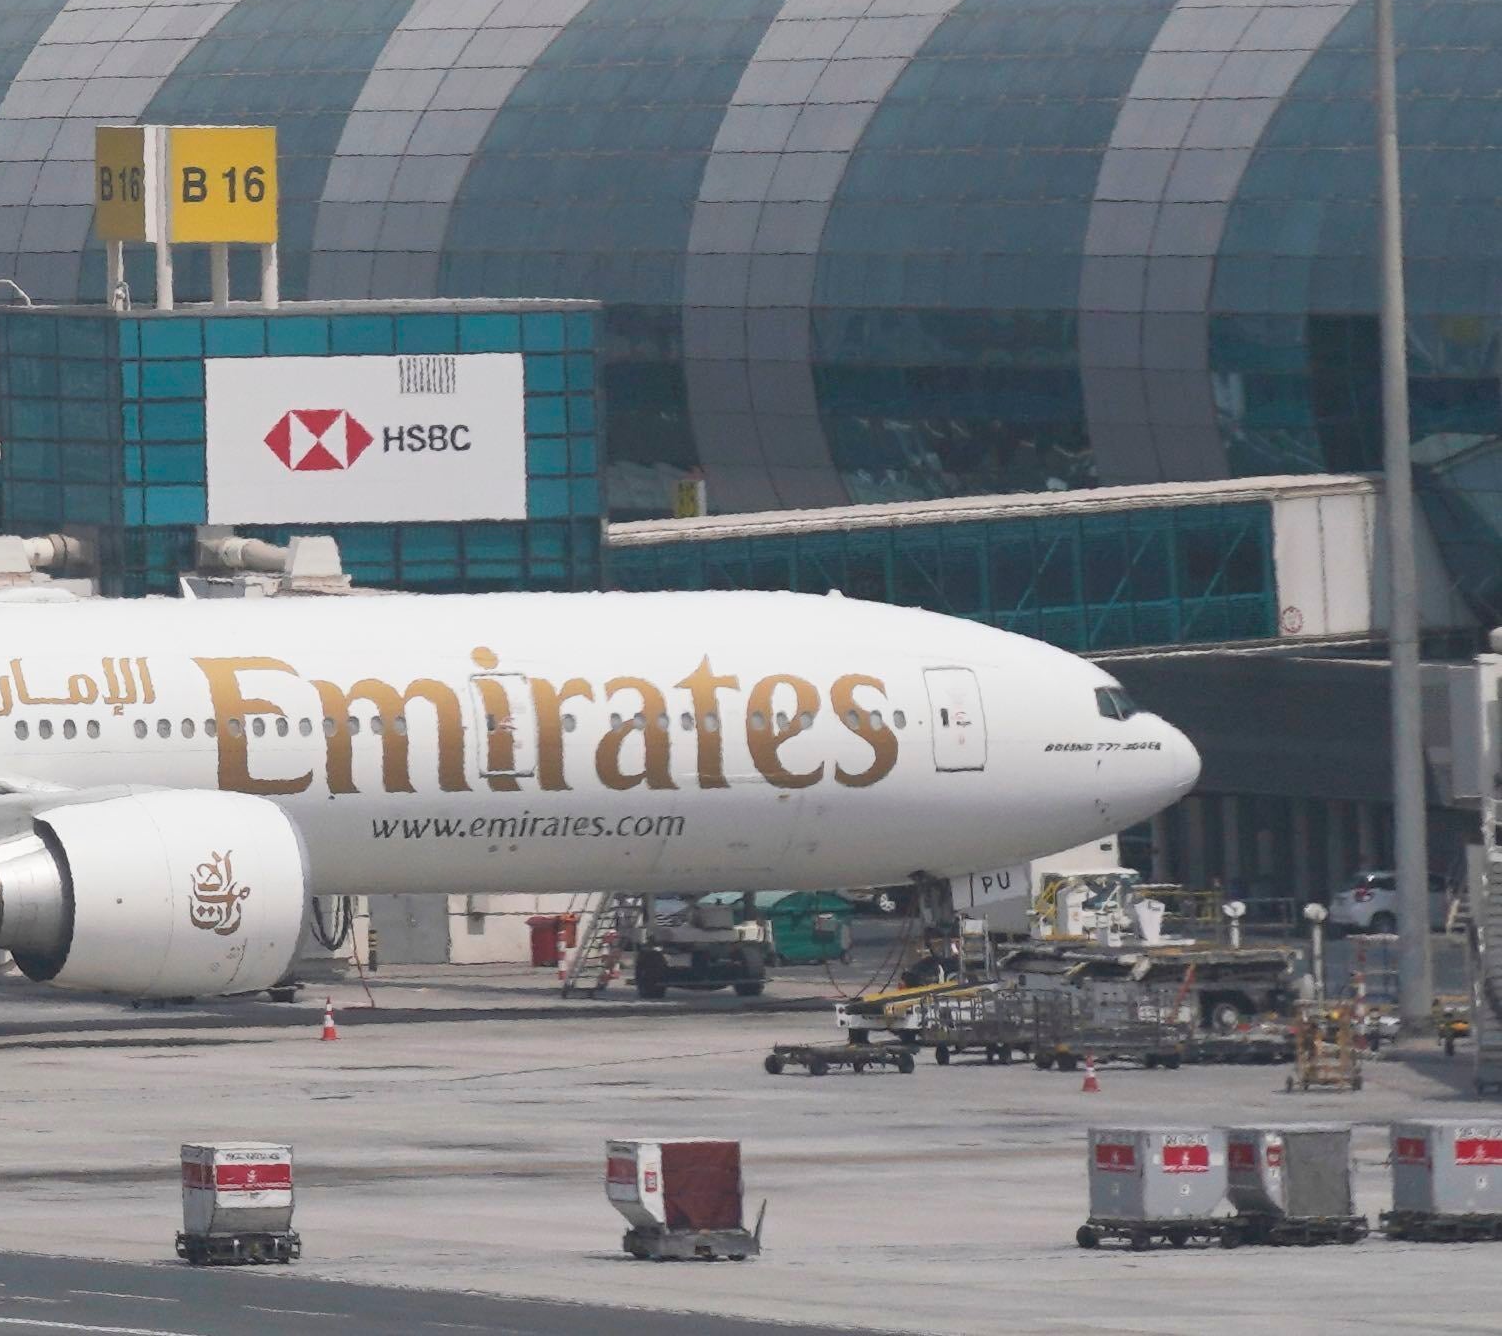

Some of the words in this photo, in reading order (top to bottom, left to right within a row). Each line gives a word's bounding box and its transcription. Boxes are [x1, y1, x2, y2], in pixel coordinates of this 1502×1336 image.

[182, 166, 207, 203] B
[222, 165, 265, 203] 16
[383, 423, 471, 453] HSBC
[190, 645, 899, 794] Emirates
[371, 810, 686, 840] www.emirates.com
[981, 871, 1010, 894] PU
